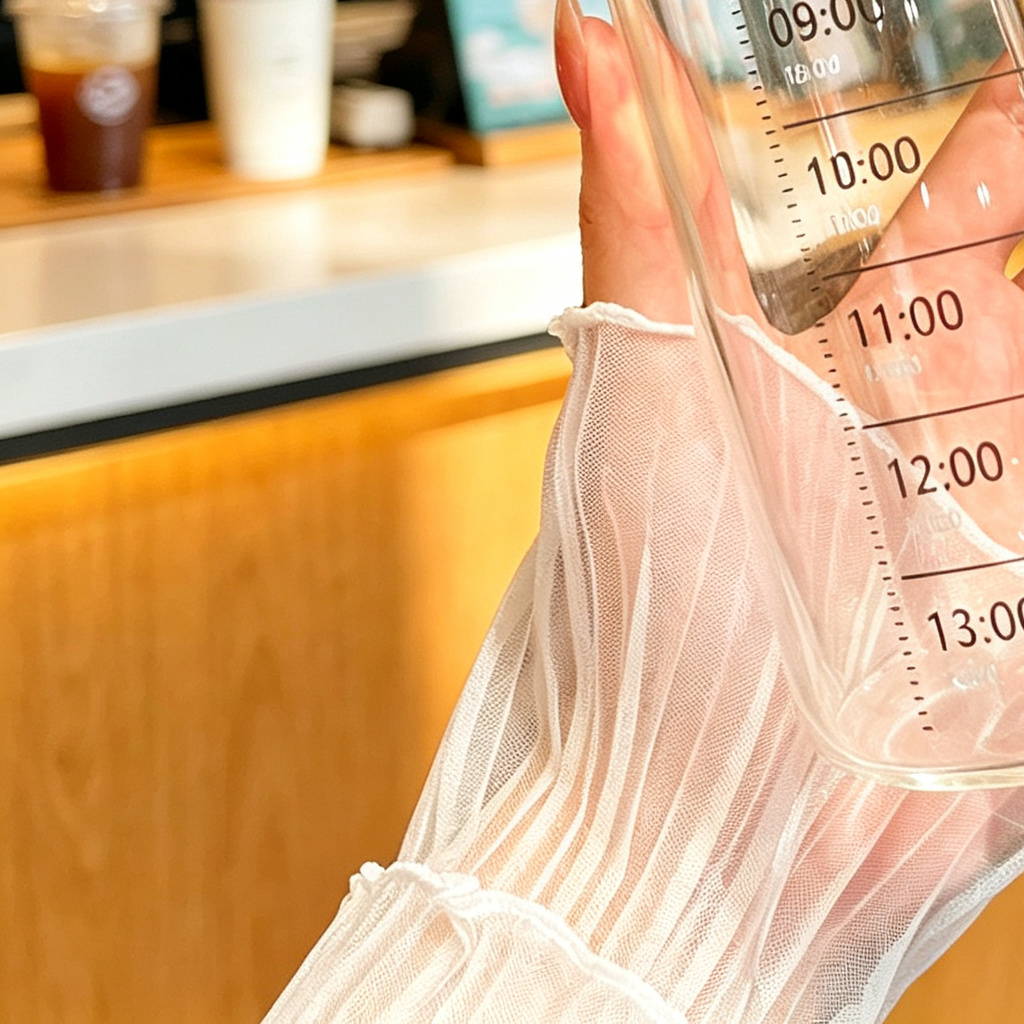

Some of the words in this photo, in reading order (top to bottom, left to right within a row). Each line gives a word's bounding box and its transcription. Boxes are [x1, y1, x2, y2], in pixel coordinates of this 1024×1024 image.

[807, 136, 921, 195] 10:00
[848, 289, 963, 348] 11:00
[888, 441, 1003, 499] 12:00
